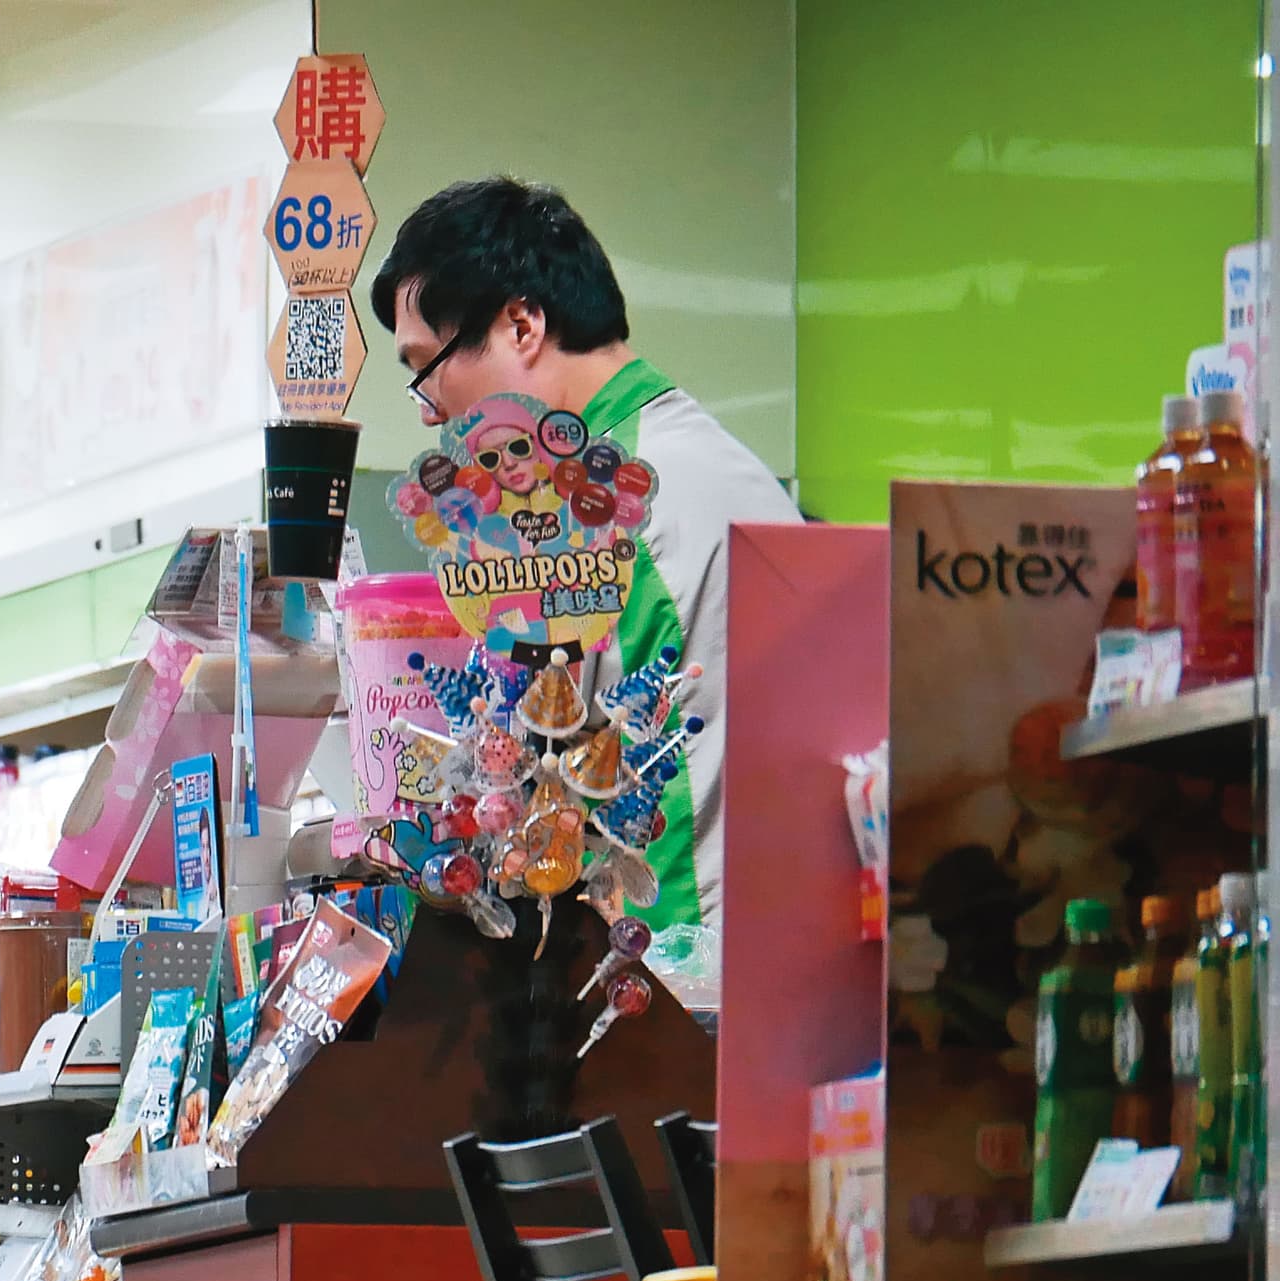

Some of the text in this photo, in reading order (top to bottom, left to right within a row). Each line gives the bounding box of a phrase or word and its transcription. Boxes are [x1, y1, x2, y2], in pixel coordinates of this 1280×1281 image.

[293, 67, 366, 161] 購
[274, 195, 363, 252] 68折
[444, 550, 618, 597] LOLLIPOPS
[916, 529, 1091, 598] kotex
[366, 683, 439, 714] Popco
